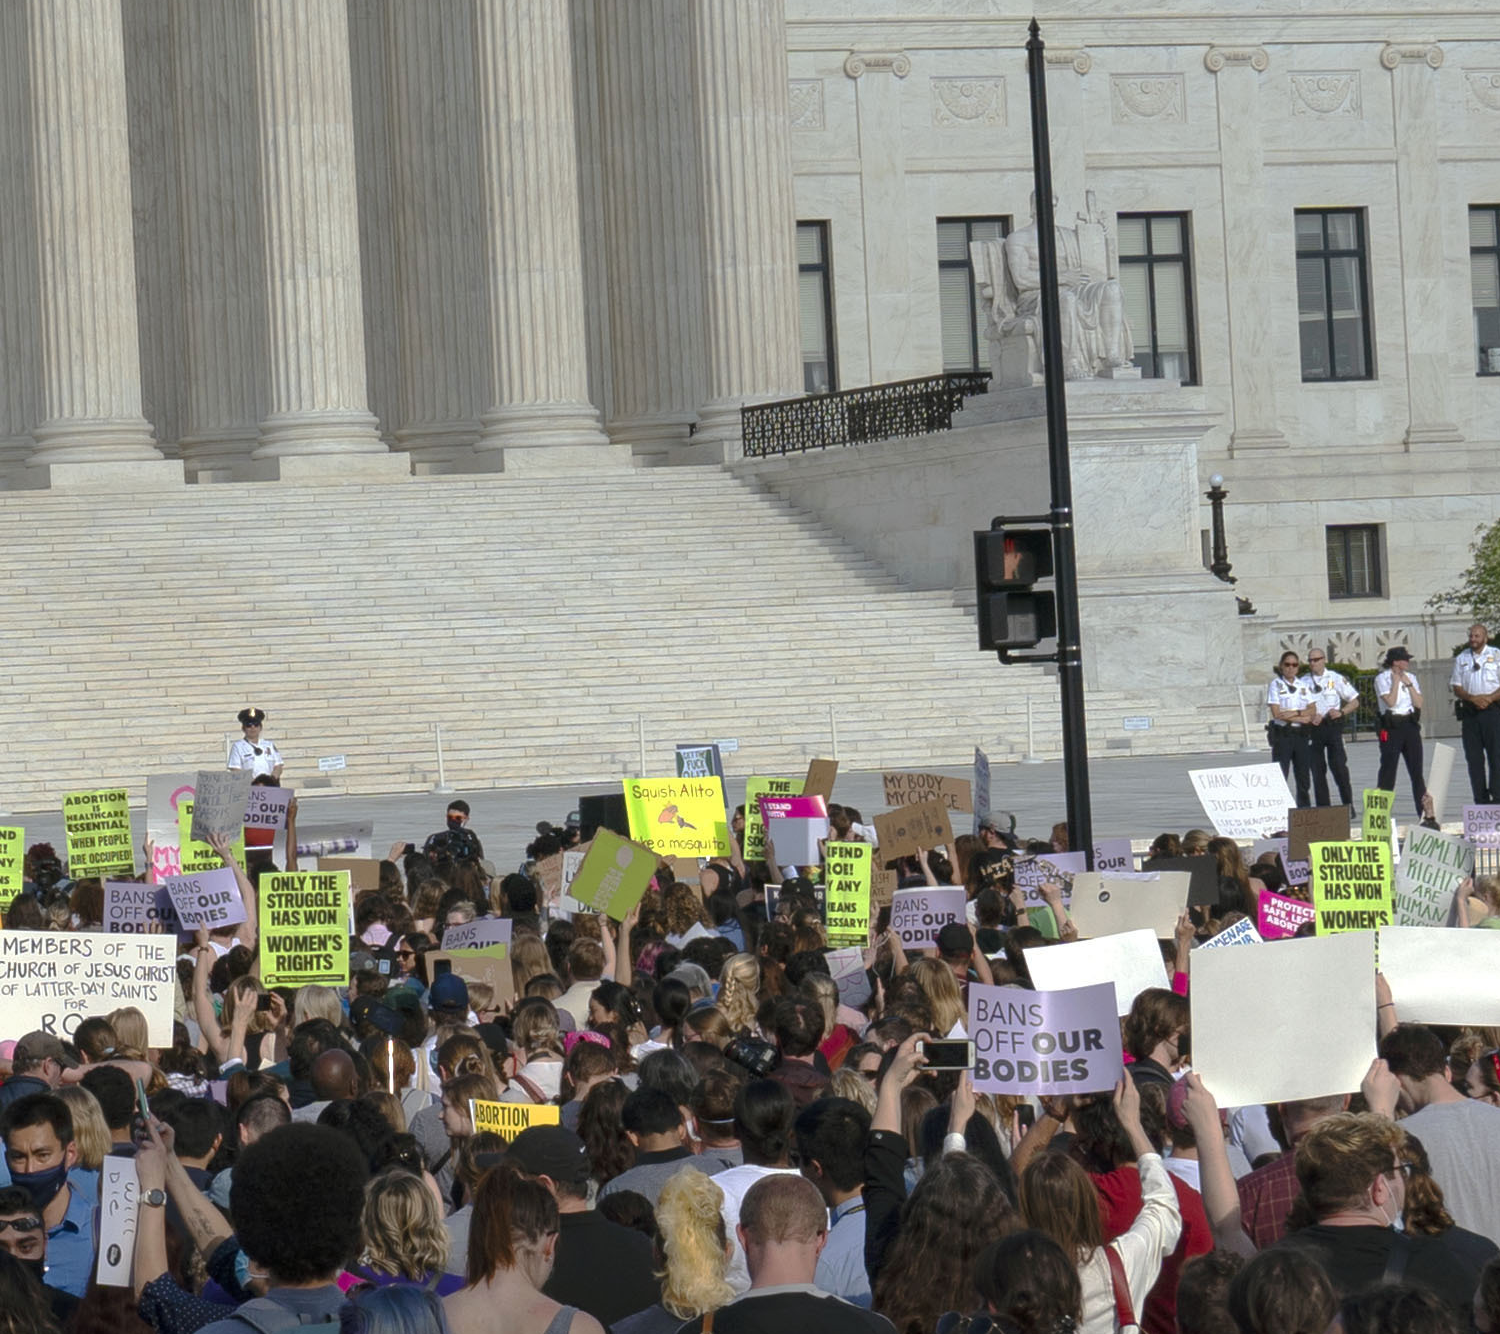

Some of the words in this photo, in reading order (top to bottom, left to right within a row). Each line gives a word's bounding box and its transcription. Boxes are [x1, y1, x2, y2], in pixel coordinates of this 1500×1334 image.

[768, 781, 790, 792] THE
[884, 774, 906, 790] MY
[907, 774, 946, 789] BODY
[1198, 774, 1238, 789] THANK
[1244, 773, 1269, 788] YOU
[65, 792, 126, 806] ABORTION
[632, 785, 677, 801] Squish
[680, 783, 714, 797] Alito
[887, 791, 914, 805] MY
[260, 803, 285, 813] OUR
[767, 802, 792, 811] STAND
[1208, 799, 1253, 812] JUSTICE
[1468, 810, 1500, 821] BANS
[67, 820, 128, 833] ESSENTIAL,
[1468, 822, 1492, 833] OFF
[70, 836, 96, 849] WHEN
[98, 834, 129, 847] PEOPLE
[669, 837, 725, 857] mosquito
[70, 854, 87, 865] ARE
[89, 850, 132, 863] OCCUPIED!
[154, 846, 180, 864] MY
[1321, 847, 1352, 862] ONLY
[1353, 846, 1379, 862] THE
[1097, 857, 1127, 870] OUR
[1320, 864, 1384, 881] STRUGGLE
[170, 880, 201, 894] BANS
[271, 876, 307, 892] ONLY
[310, 876, 337, 891] THE
[836, 880, 862, 893] ANY
[1324, 883, 1352, 900] HAS
[1355, 883, 1382, 900] WON
[110, 891, 155, 903] BANS
[176, 898, 195, 910] OFF
[197, 891, 232, 908] OUR
[267, 892, 341, 909] STRUGGLE
[1412, 884, 1442, 904] ARE
[110, 906, 142, 919] OFF
[895, 898, 928, 913] BANS
[1271, 898, 1315, 916] PROTECT
[271, 910, 300, 926] HAS
[303, 910, 337, 925] WON
[893, 916, 919, 928] OFF
[922, 913, 957, 925] OUR
[1321, 910, 1389, 929] WOMEN'S
[267, 934, 342, 953] WOMEN'S
[445, 928, 476, 946] BANS
[3, 938, 93, 957] MEMBERS
[104, 943, 126, 957] OF
[136, 945, 165, 960] THE
[276, 954, 333, 971] RIGHTS
[64, 963, 81, 975] OF
[85, 963, 131, 980] JESUS
[135, 965, 176, 983] CHRIST
[1, 984, 18, 996] OF
[25, 981, 106, 996] LATTER-DAY
[112, 982, 157, 1001] SAINTS
[64, 999, 88, 1011] FOR
[977, 999, 1044, 1027] BANS
[975, 1028, 1025, 1054] OFF
[1031, 1029, 1104, 1055] OUR
[974, 1058, 1089, 1083] BODIES
[475, 1104, 529, 1127] ABORTION
